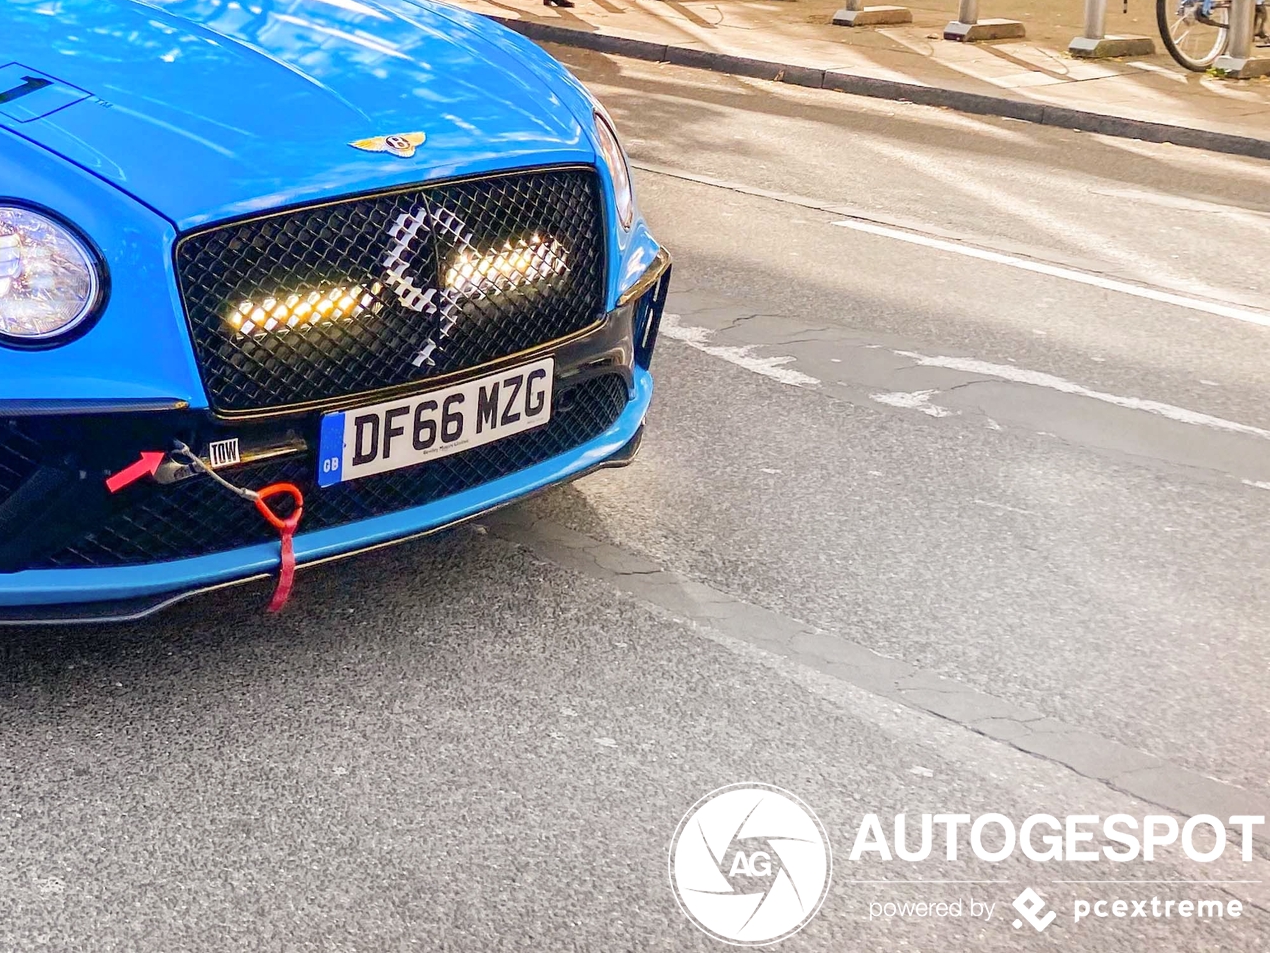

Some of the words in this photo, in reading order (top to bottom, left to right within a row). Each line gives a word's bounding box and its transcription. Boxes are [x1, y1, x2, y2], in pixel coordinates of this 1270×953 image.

[352, 393, 465, 467] DF66
[476, 368, 547, 435] MZG
[211, 440, 237, 465] TOW
[323, 456, 339, 473] GB
